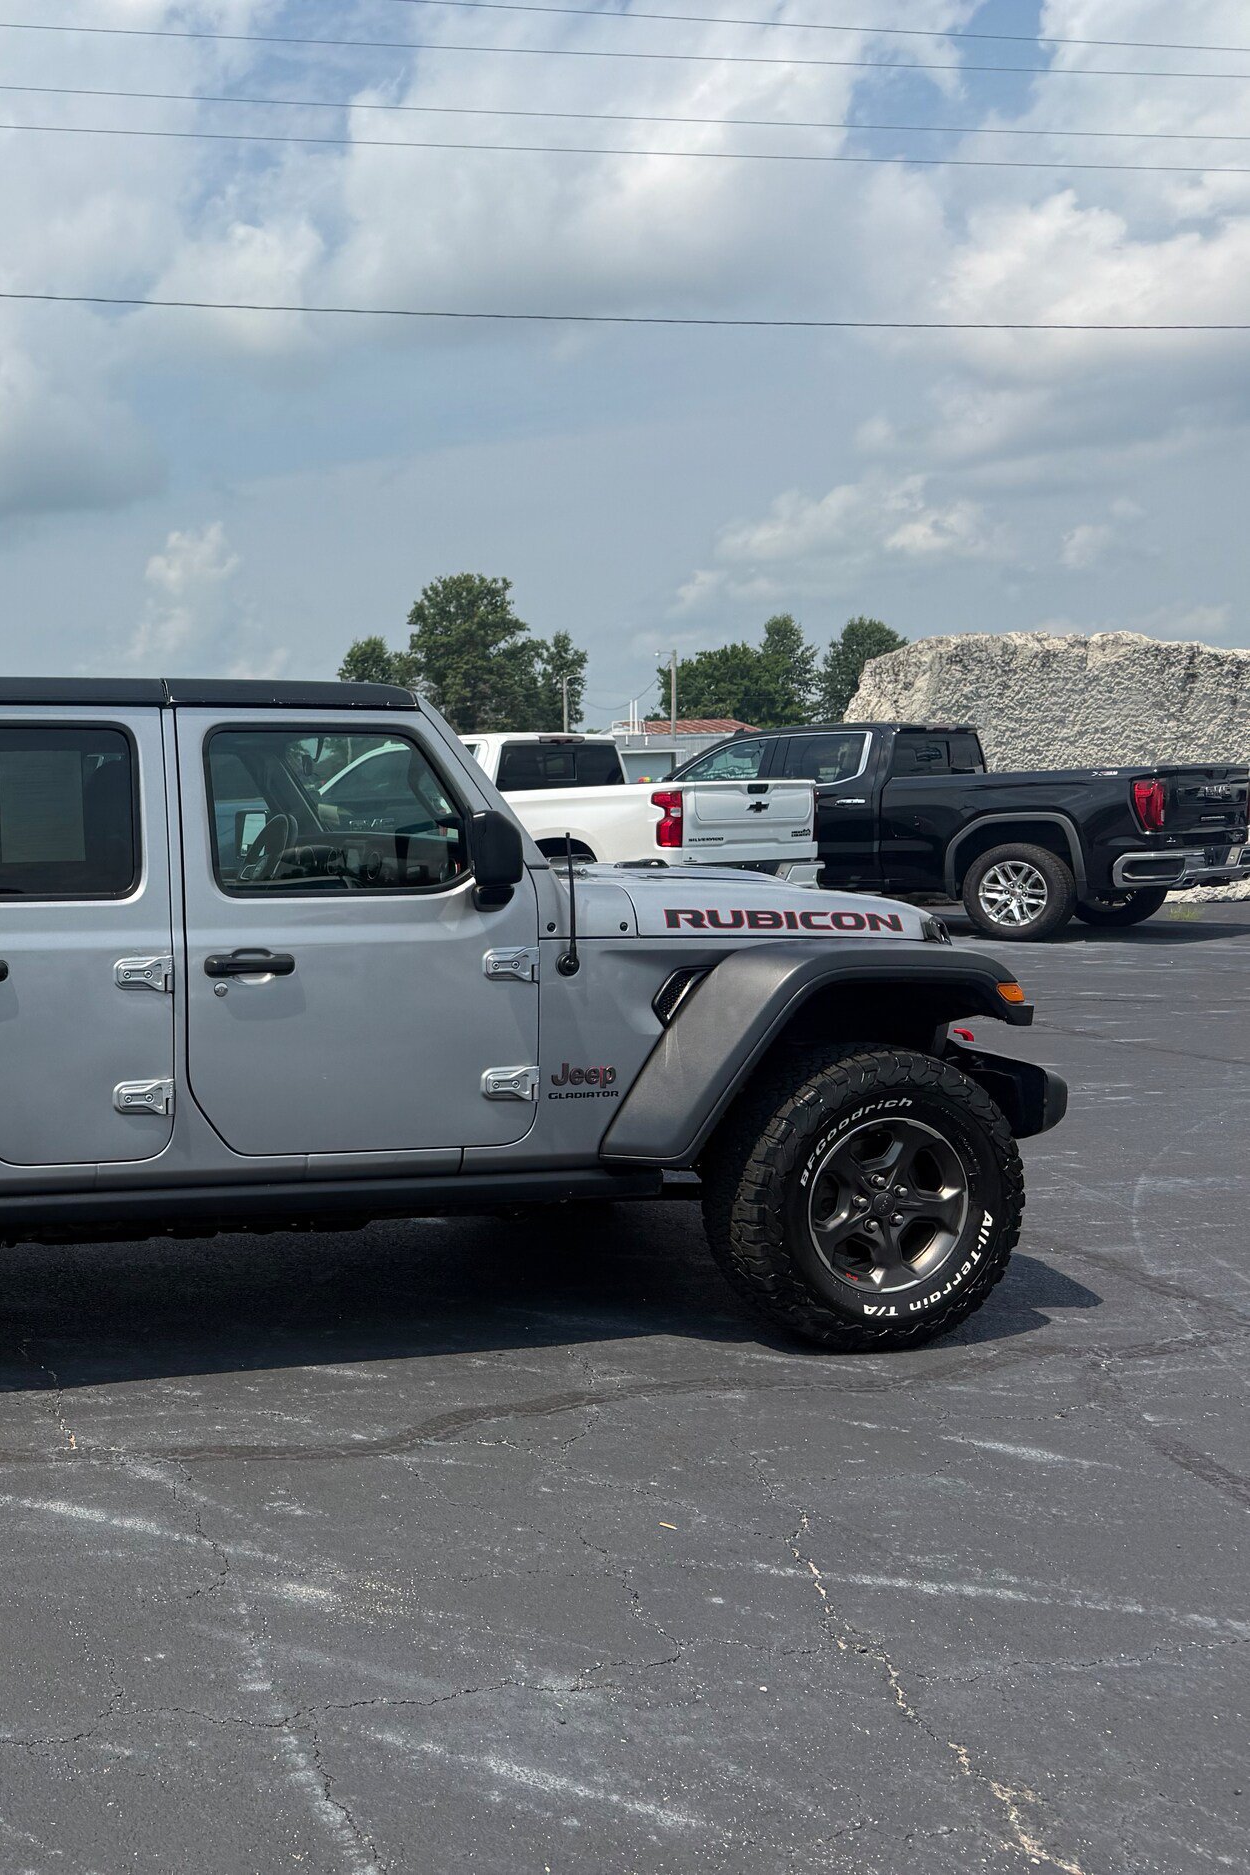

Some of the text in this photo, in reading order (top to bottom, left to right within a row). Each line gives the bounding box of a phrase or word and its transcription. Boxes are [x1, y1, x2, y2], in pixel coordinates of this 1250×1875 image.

[663, 908, 904, 932] RUBICON
[551, 1062, 617, 1089] Jeep
[548, 1090, 619, 1100] GLADIATOR
[800, 1097, 913, 1187] BFGoodrich
[863, 1209, 994, 1317] All-Terrain T/A
